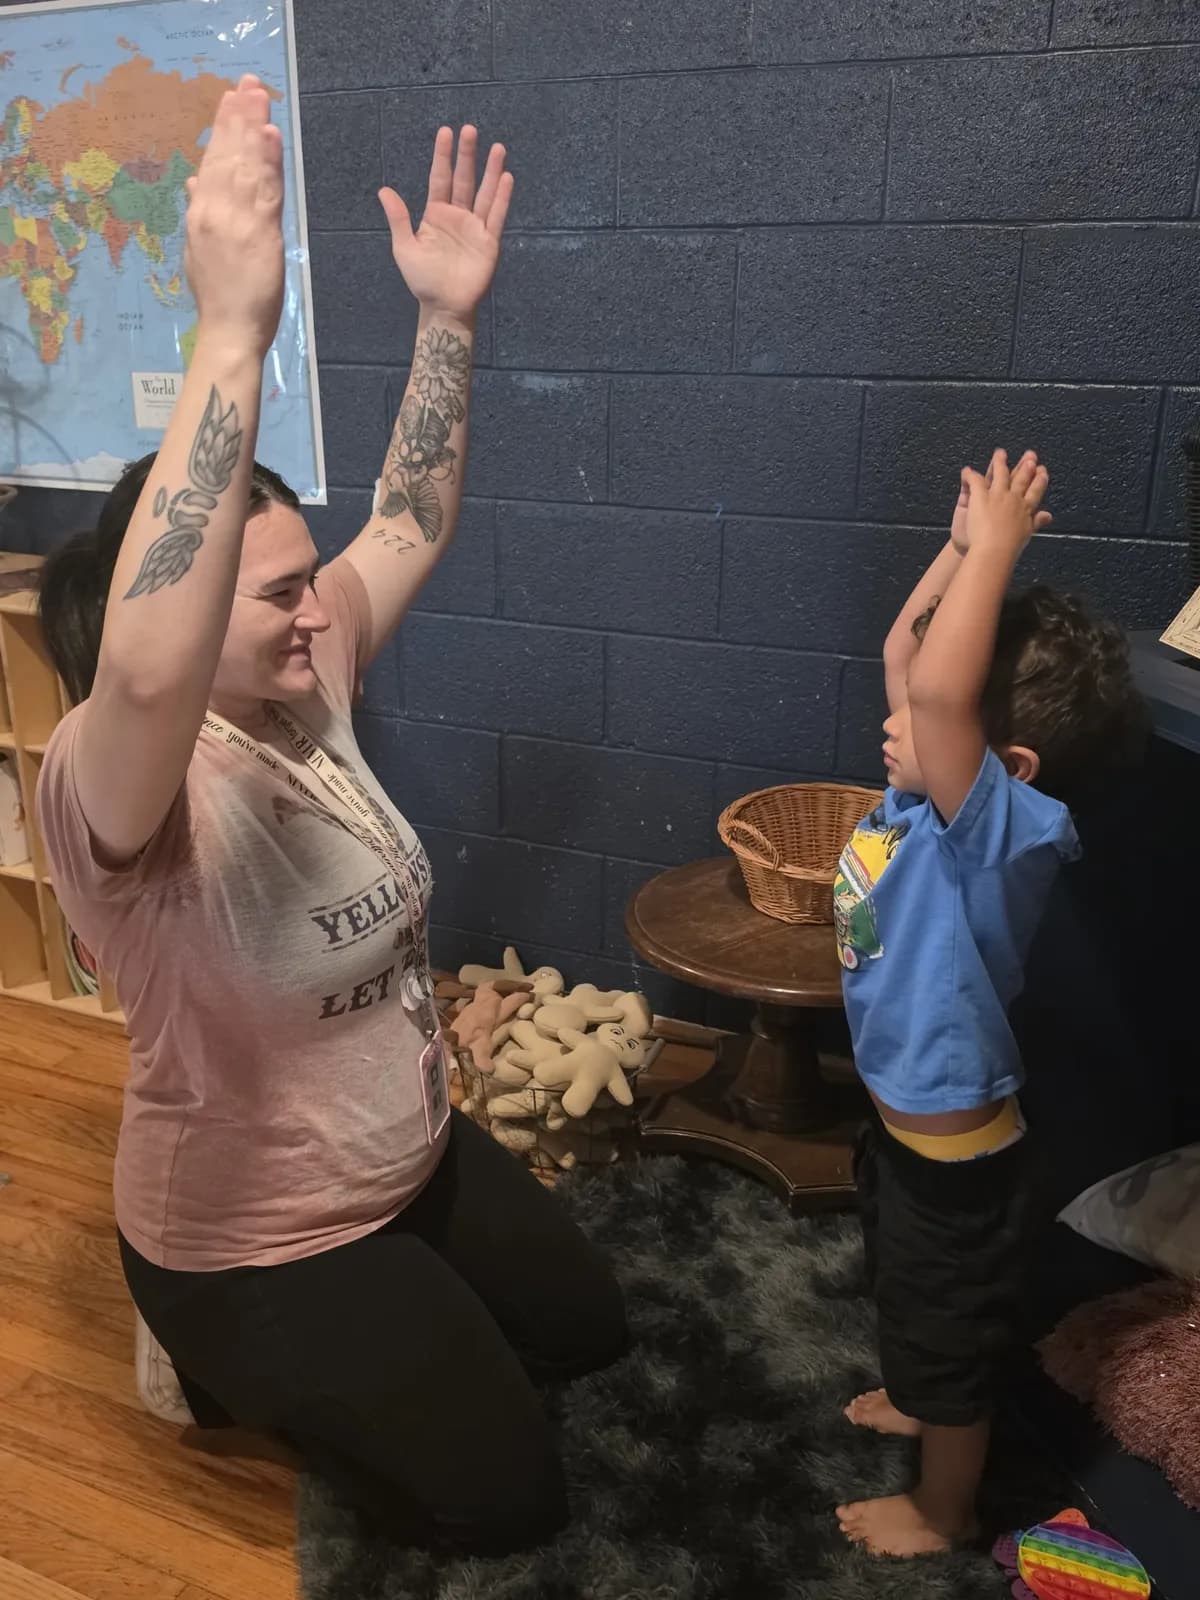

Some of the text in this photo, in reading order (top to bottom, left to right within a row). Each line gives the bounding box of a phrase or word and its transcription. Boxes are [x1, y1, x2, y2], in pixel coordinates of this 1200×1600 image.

[118, 322, 144, 331] OCEAN
[141, 378, 176, 395] World
[226, 732, 256, 753] you've
[256, 751, 279, 769] made
[295, 735, 325, 769] NEVER
[327, 773, 348, 794] made
[345, 794, 370, 817] you've
[318, 964, 395, 1020] LET
